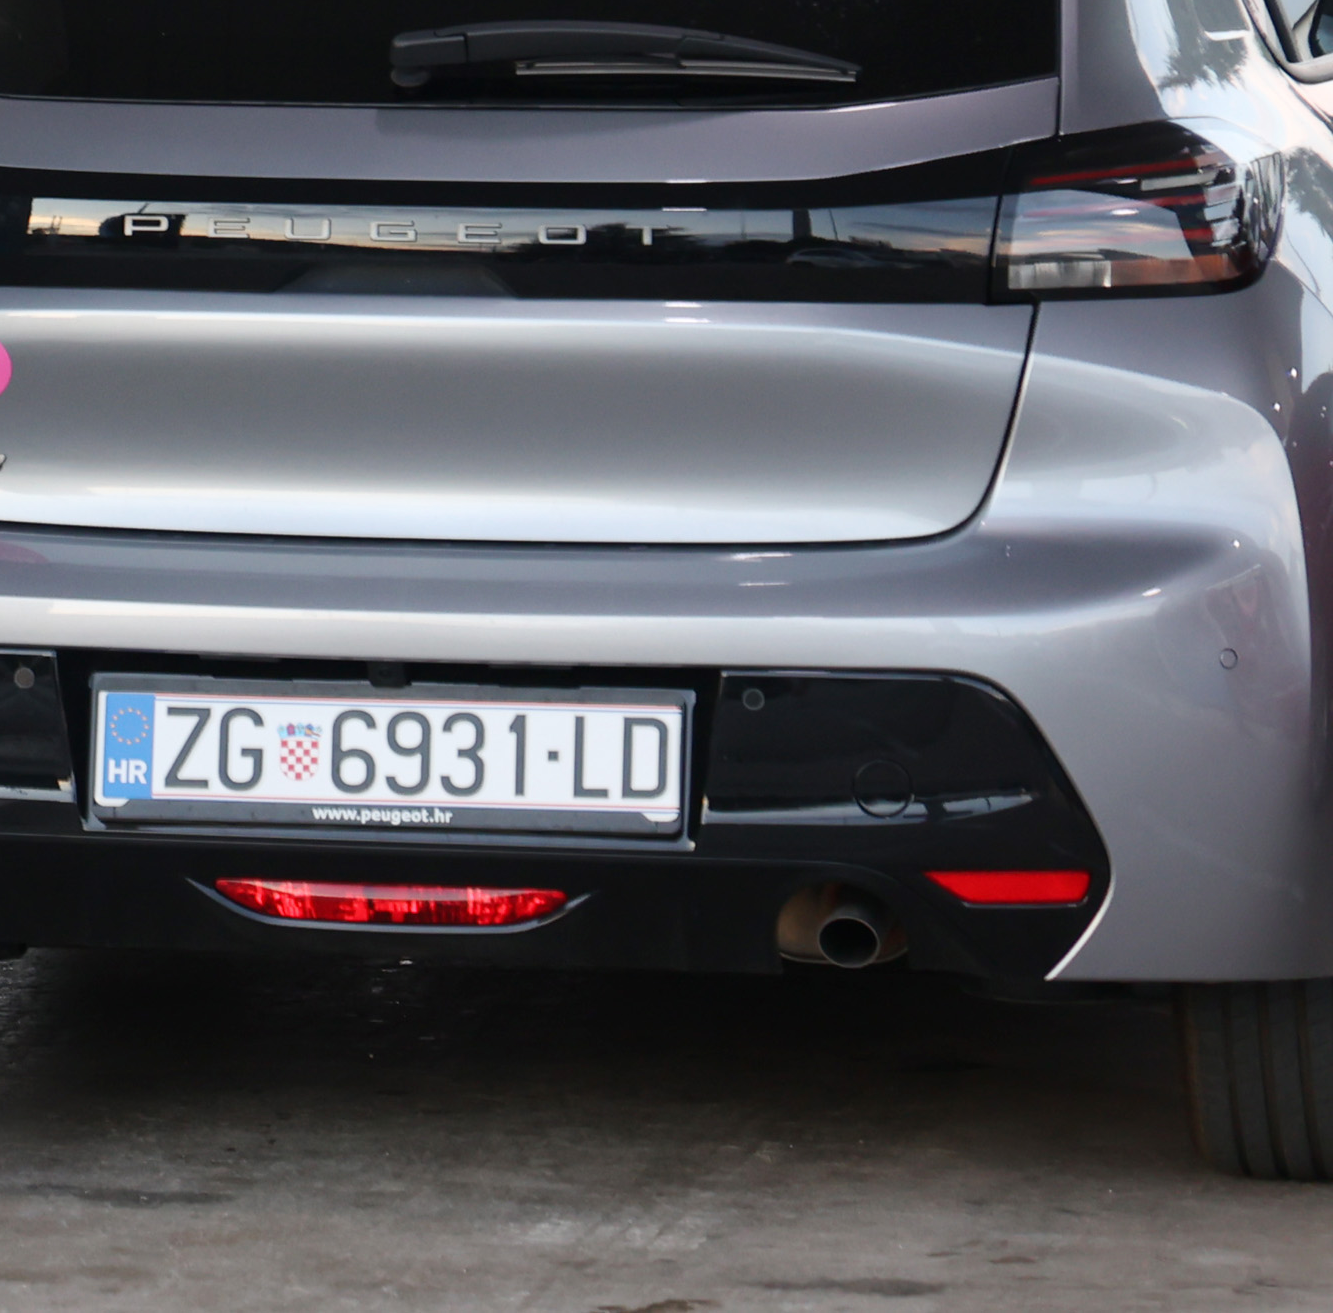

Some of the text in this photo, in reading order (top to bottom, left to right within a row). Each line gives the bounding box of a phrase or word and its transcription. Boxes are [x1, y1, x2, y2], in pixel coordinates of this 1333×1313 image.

[123, 213, 674, 247] PEUGEOT
[107, 758, 147, 785] HR
[163, 706, 266, 792] ZG
[312, 805, 453, 827] www.peugeot.hr
